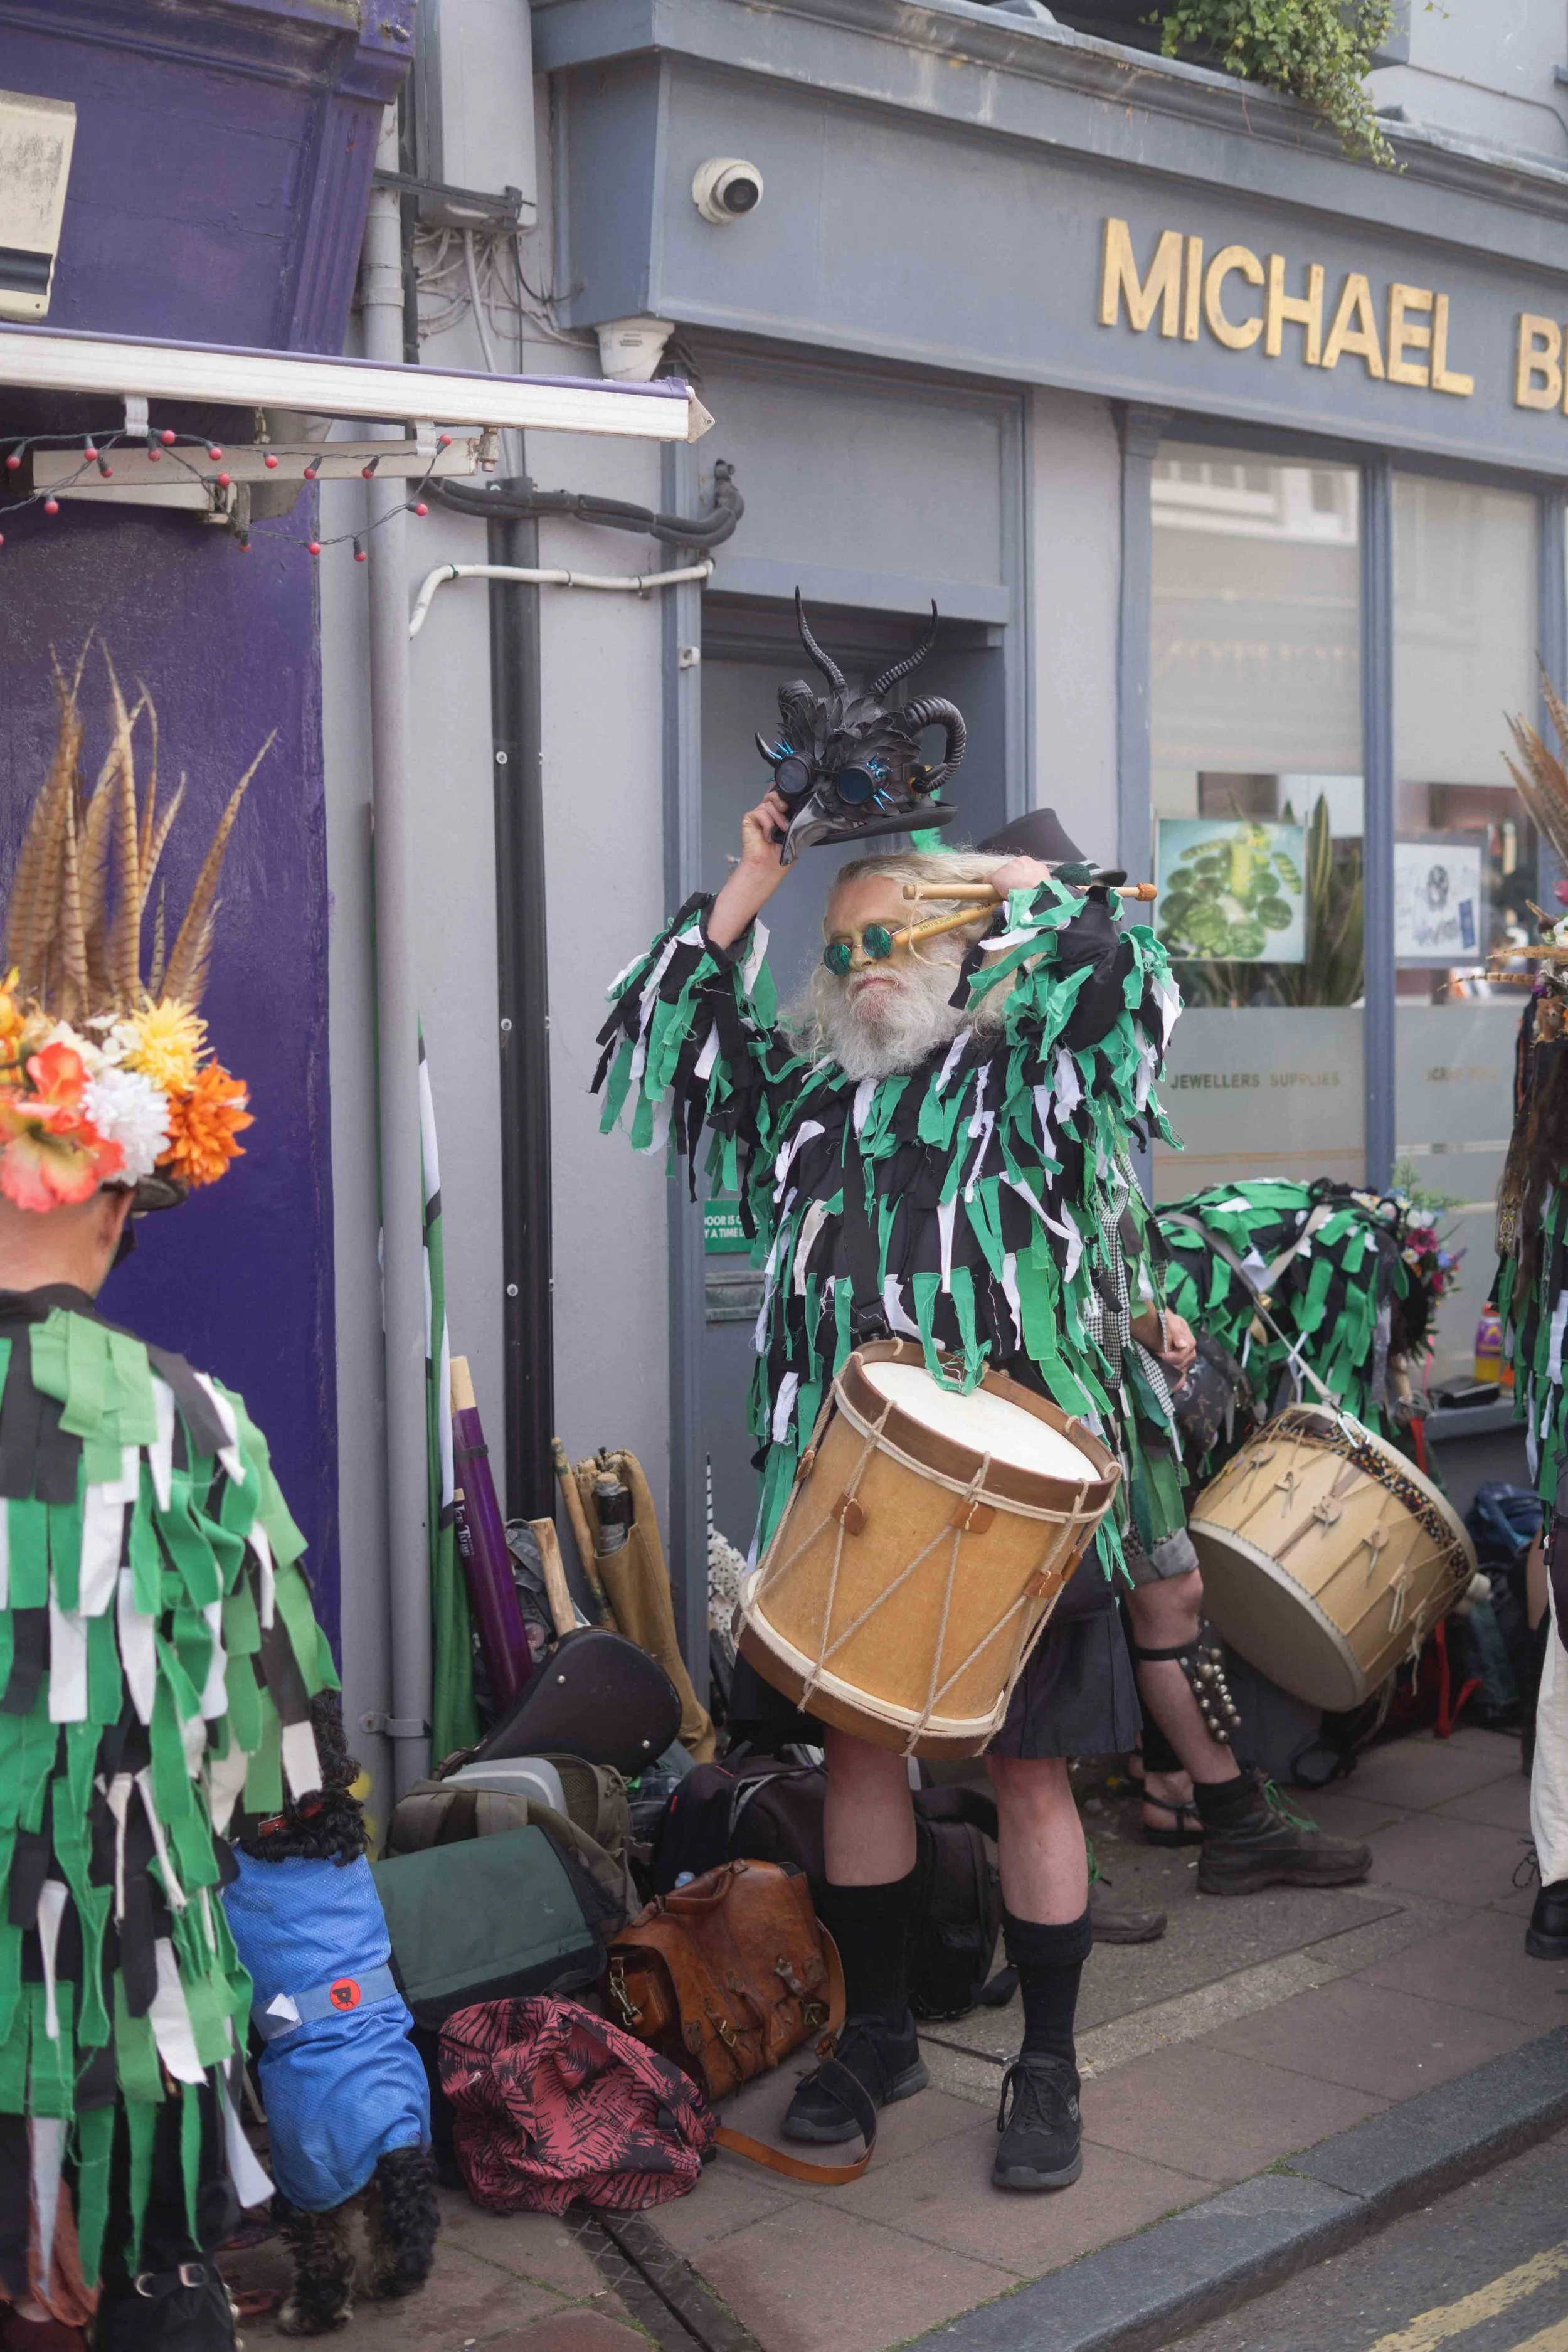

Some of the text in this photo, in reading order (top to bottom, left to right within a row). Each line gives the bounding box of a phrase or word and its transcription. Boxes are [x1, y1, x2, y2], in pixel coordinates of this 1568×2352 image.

[1098, 217, 1568, 416] MICHAEL B
[1170, 1071, 1340, 1090] JEWELLERS SUPPLIES
[728, 1215, 735, 1225] IS
[711, 1227, 718, 1239] A
[718, 1227, 738, 1239] TIME
